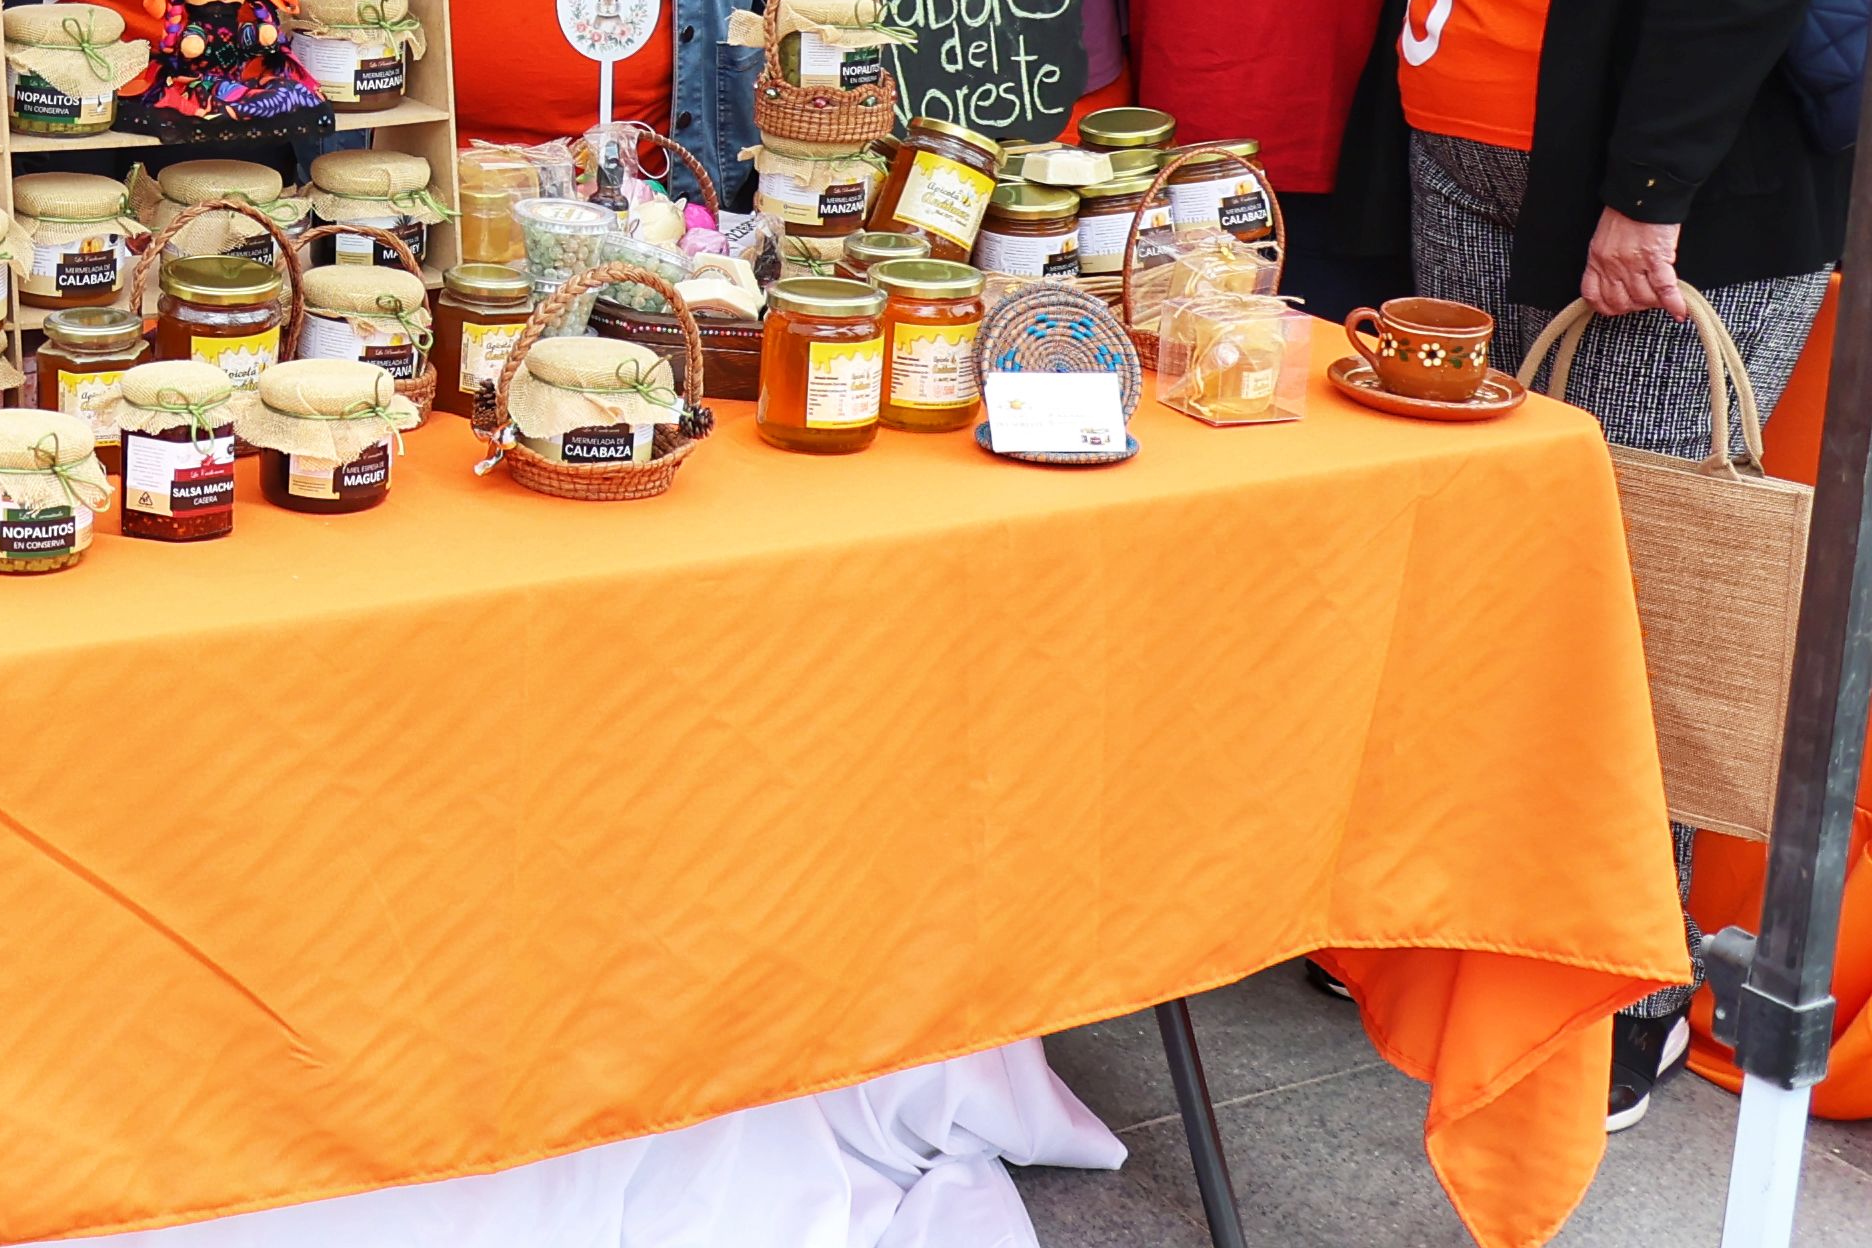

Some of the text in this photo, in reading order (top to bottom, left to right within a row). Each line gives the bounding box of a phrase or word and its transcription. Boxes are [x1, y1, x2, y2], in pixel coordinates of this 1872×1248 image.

[940, 20, 998, 74] del
[356, 74, 403, 91] MANZANA
[362, 70, 394, 79] MERMELADA
[16, 90, 80, 106] NOPALITOS
[24, 104, 69, 115] EN CONSERVA
[1221, 208, 1267, 226] CALABAZA
[65, 264, 103, 274] MERMELADA
[58, 270, 116, 286] CALABAZA
[571, 436, 615, 445] MERMELADA
[564, 444, 631, 458] CALABAZA
[343, 469, 385, 486] MAGUEY
[172, 481, 234, 498] SALSA MACHA
[193, 495, 218, 505] CASERA
[2, 522, 74, 539] NOPALITOS
[13, 538, 66, 550] EN CONSERVA
